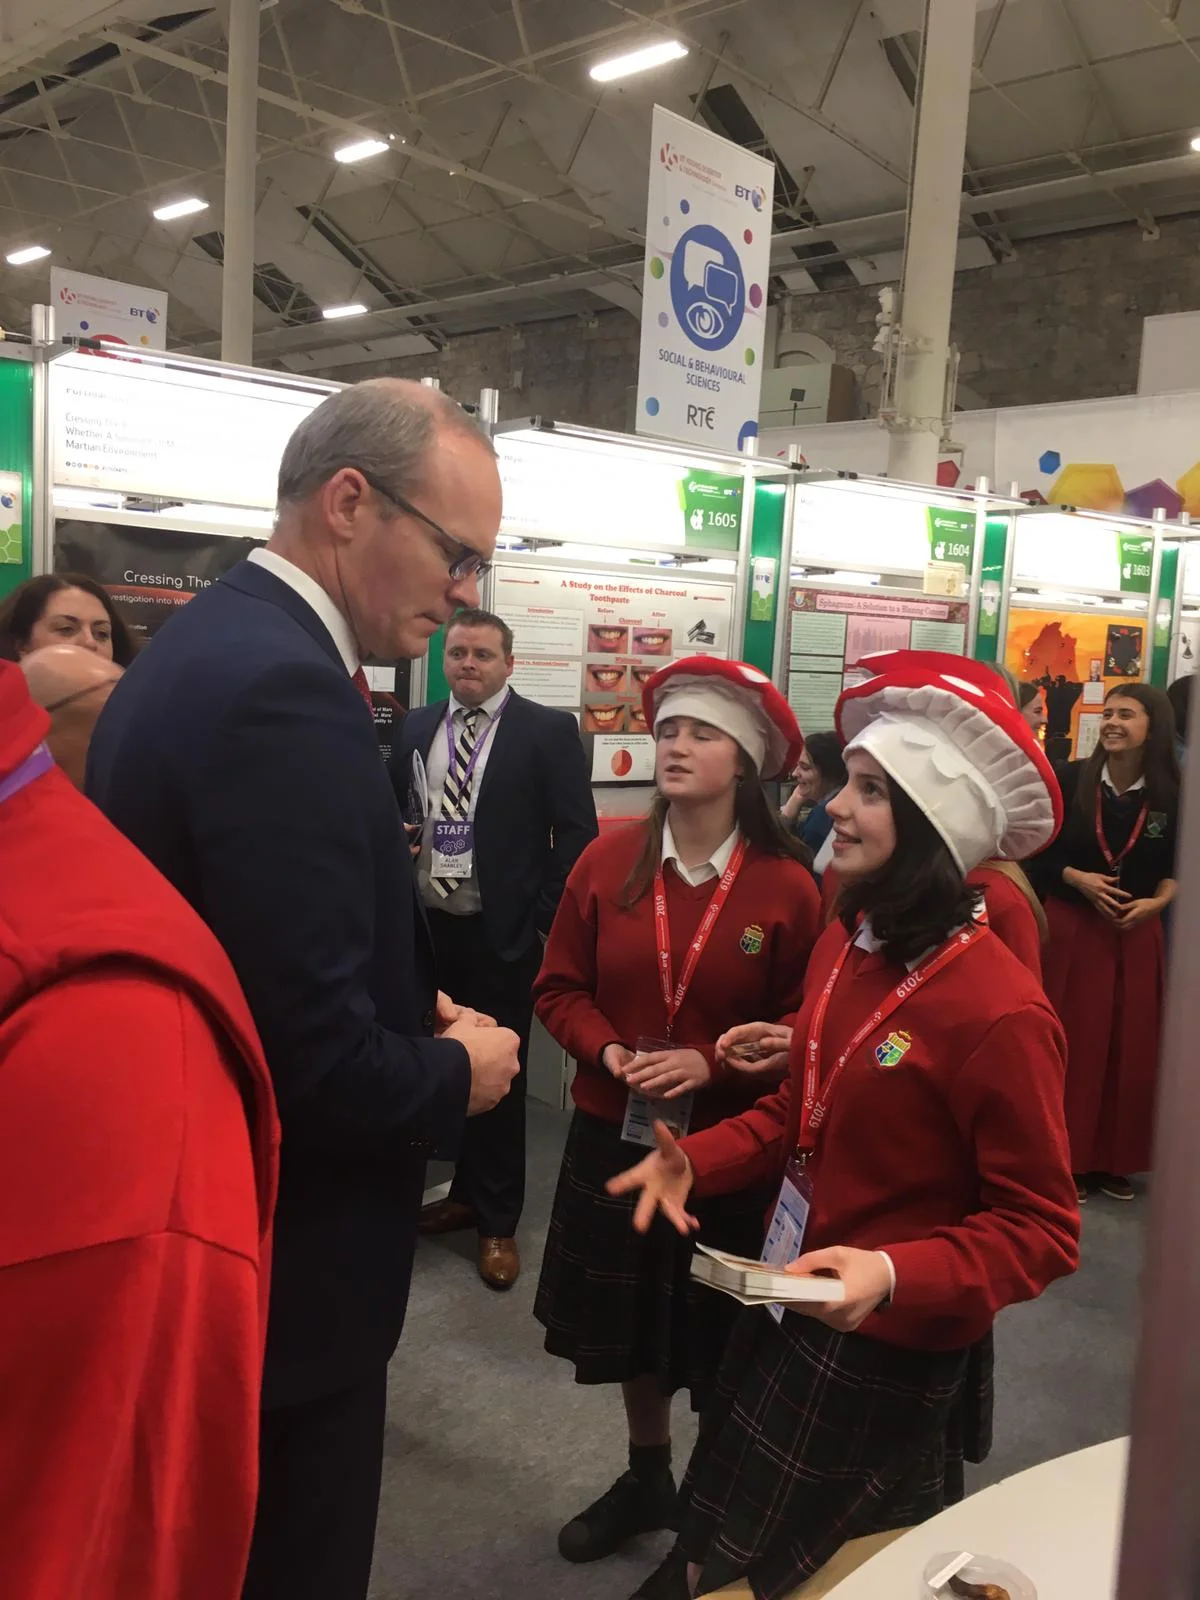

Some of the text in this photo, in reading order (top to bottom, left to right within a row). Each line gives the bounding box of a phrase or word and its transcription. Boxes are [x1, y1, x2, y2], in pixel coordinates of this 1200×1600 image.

[734, 184, 750, 200] BT
[130, 308, 145, 318] BT
[658, 348, 746, 384] SOCIAL & BEHAVIOURAL
[686, 373, 720, 392] SCIENCES
[66, 439, 100, 451] Martian
[708, 512, 736, 528] 1605
[948, 543, 970, 557] 1604
[124, 570, 212, 589] Cressing The
[561, 580, 567, 588] A
[569, 580, 592, 590] Study
[605, 584, 618, 592] the
[619, 585, 643, 594] Effects
[654, 588, 687, 596] Charcoal
[156, 596, 172, 605] into
[590, 594, 630, 604] Toothpaste
[862, 601, 888, 612] Solution
[436, 825, 470, 835] STAFF
[720, 870, 736, 892] 2019
[656, 894, 666, 916] 2019
[896, 970, 925, 998] 2019
[674, 984, 687, 1006] 2019
[808, 1102, 828, 1129] 2019
